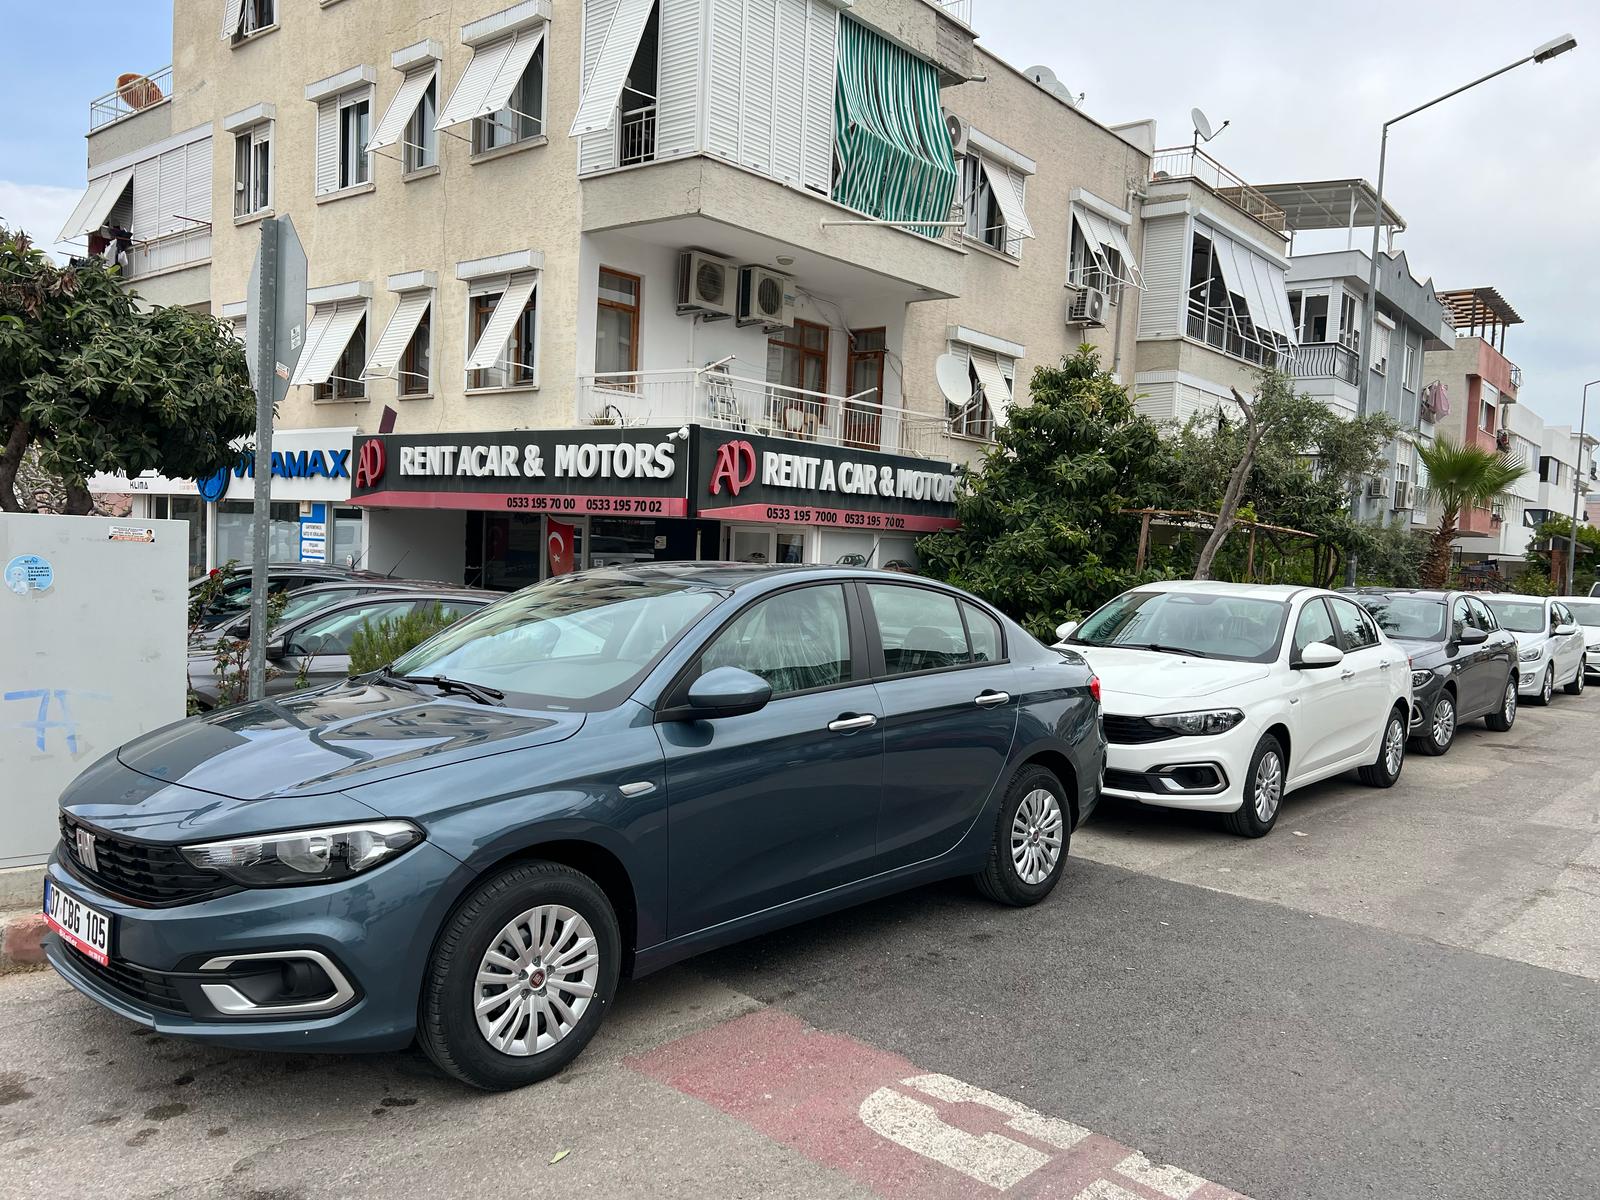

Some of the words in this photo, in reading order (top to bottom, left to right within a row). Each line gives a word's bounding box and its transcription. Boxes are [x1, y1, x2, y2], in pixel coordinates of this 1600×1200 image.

[356, 438, 385, 489] AD
[399, 445, 458, 476] RENT
[523, 444, 546, 477] &
[554, 442, 675, 479] MOTORS
[709, 439, 757, 497] AD
[761, 451, 820, 490] RENT
[879, 466, 896, 497] &
[896, 468, 962, 503] MOTOR
[506, 497, 529, 508] 0533
[531, 497, 547, 509] 195
[549, 498, 561, 509] 70
[563, 498, 576, 510] 00
[586, 498, 611, 511] 0533
[613, 500, 631, 512] 195
[633, 500, 647, 512] 70
[648, 500, 662, 513] 02
[766, 507, 790, 520] 0533
[793, 510, 811, 522] 195
[844, 513, 865, 525] 0533
[867, 515, 881, 527] 195
[49, 886, 60, 918] 07
[62, 896, 81, 934] CBG
[86, 910, 106, 949] 105
